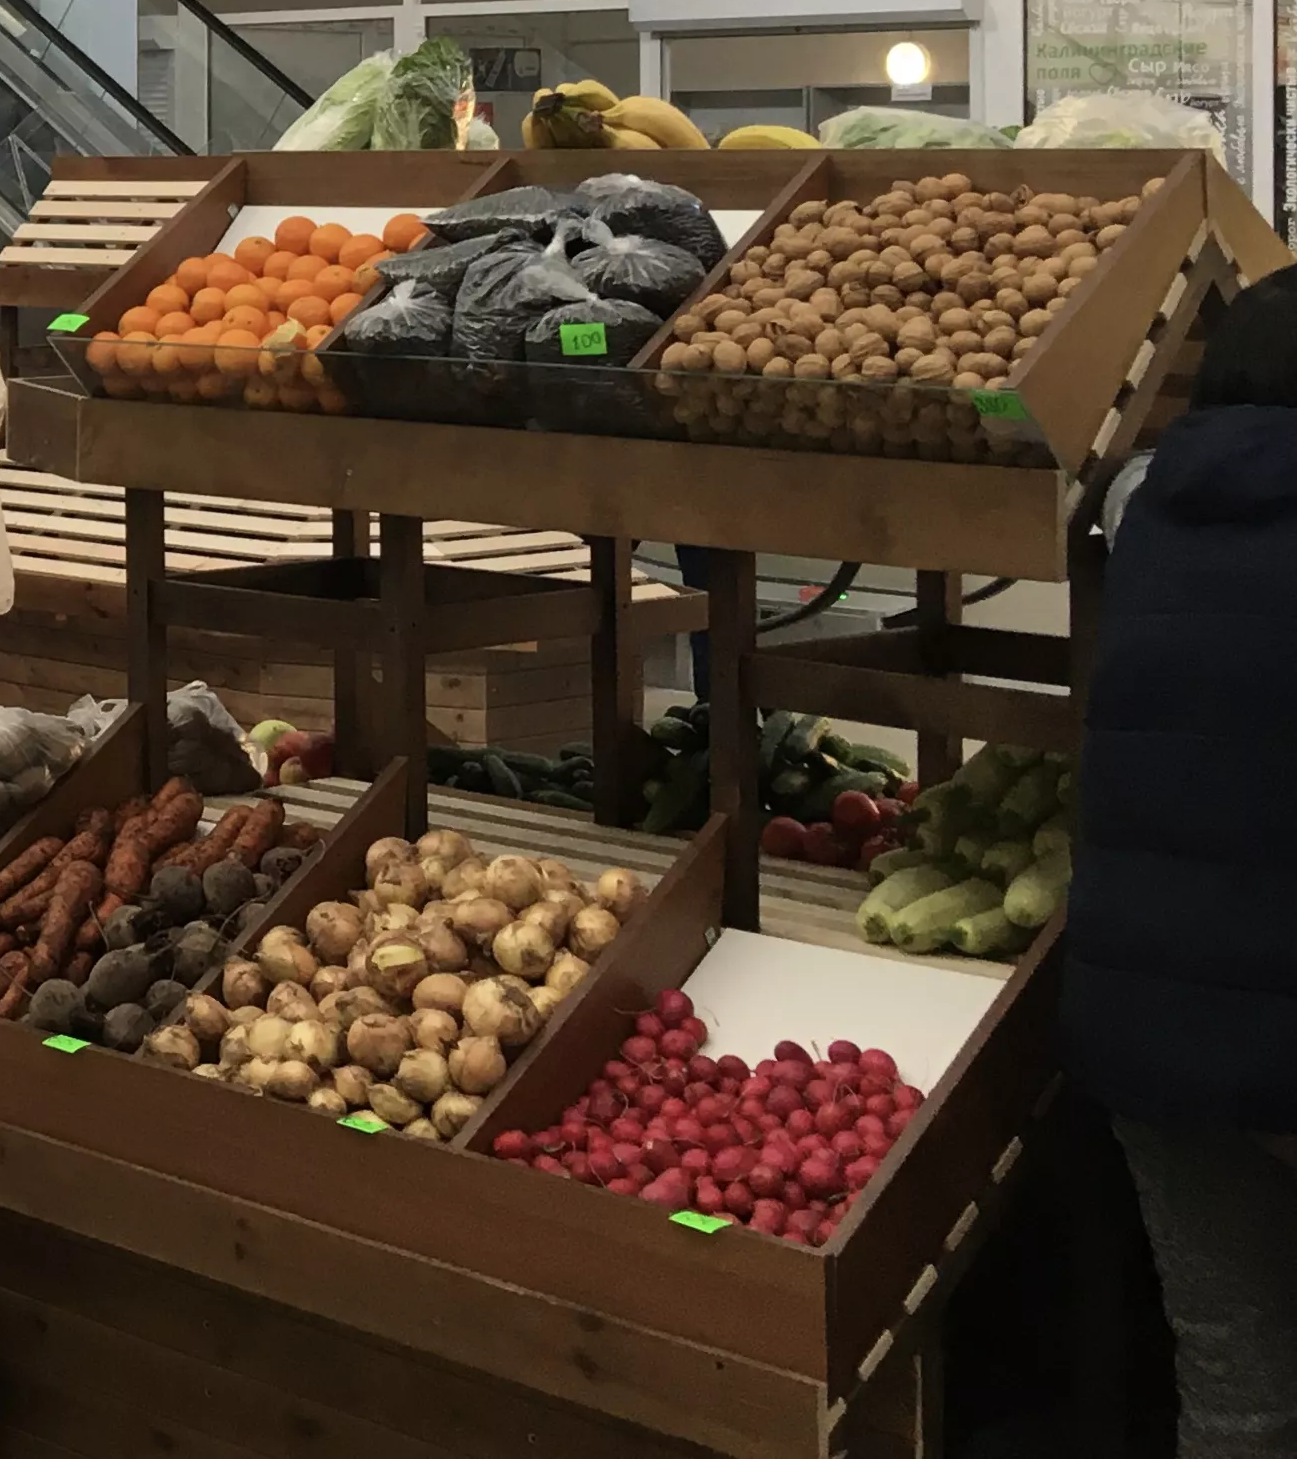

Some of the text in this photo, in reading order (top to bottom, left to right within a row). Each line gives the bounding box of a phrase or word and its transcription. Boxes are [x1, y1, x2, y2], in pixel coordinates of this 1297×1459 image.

[1036, 67, 1081, 80] поля
[1128, 57, 1167, 77] Сыр
[573, 331, 602, 351] 100
